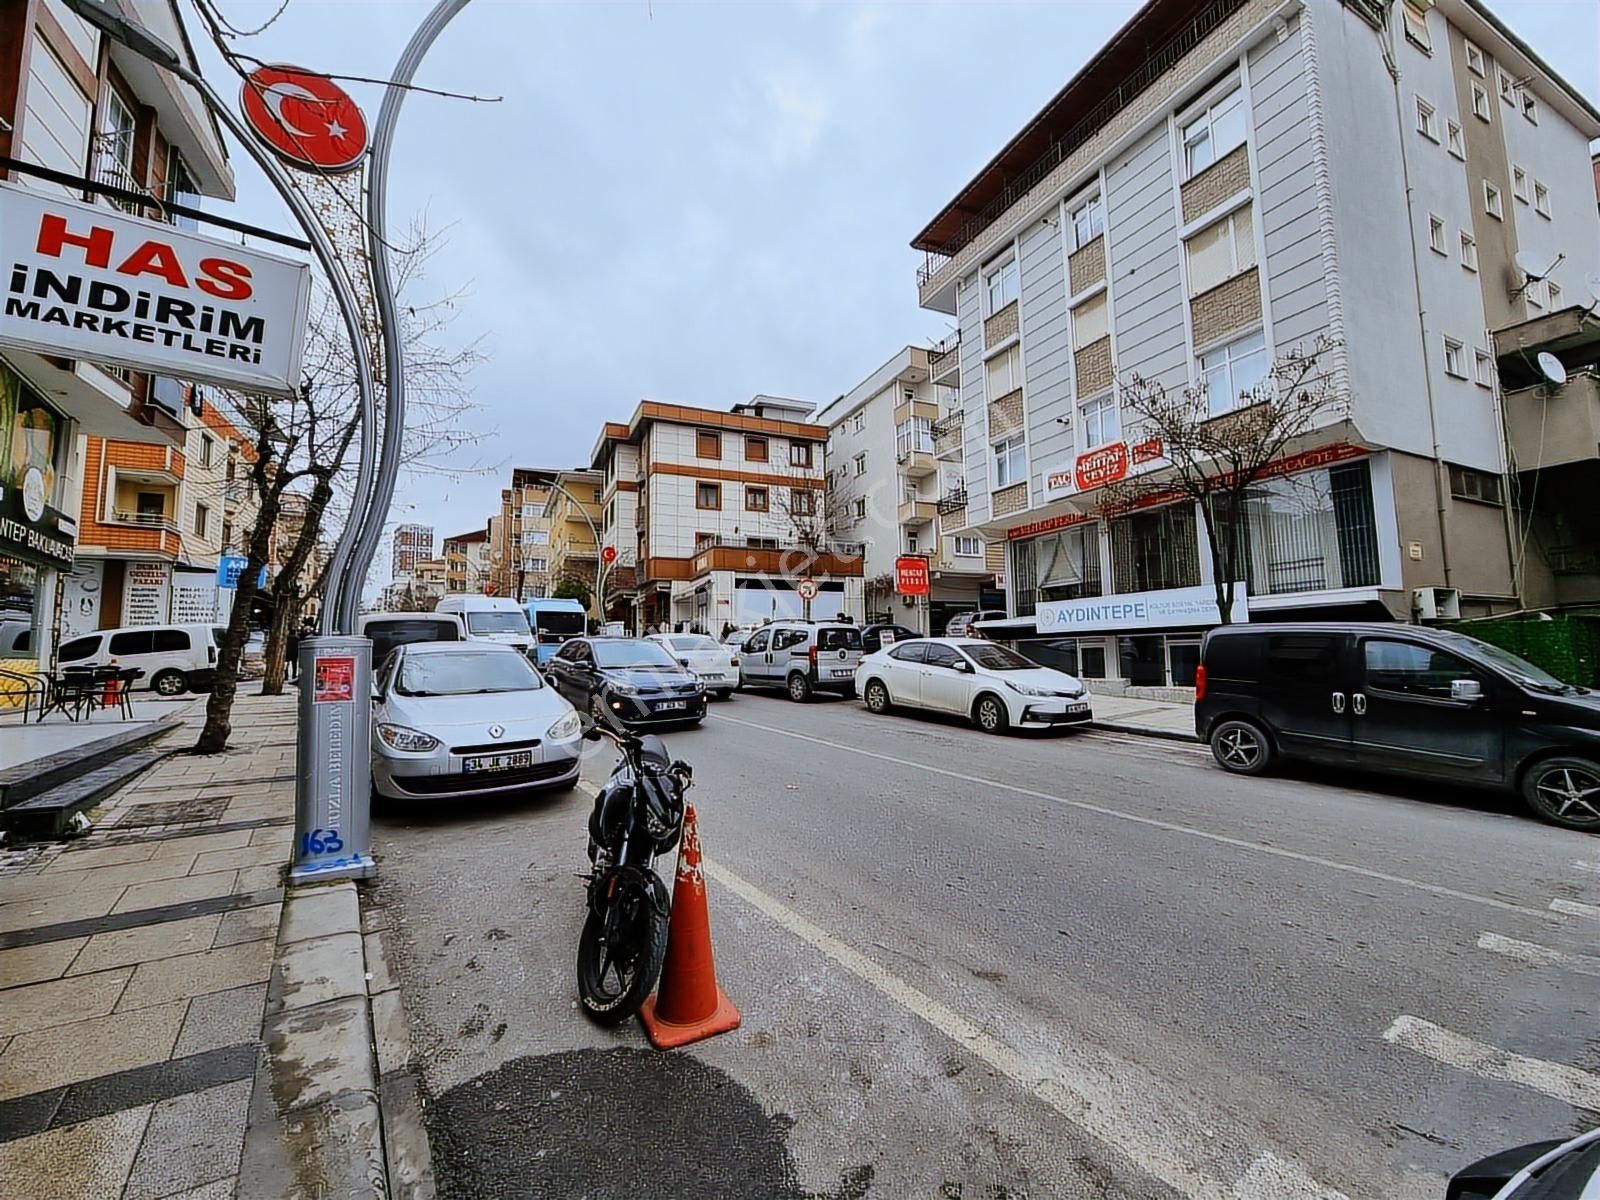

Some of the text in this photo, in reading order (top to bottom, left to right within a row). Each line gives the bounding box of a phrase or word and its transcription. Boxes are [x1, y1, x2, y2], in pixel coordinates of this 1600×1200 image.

[36, 212, 252, 301] HAS
[4, 297, 261, 364] MARKETLERİ
[1057, 602, 1145, 624] AYDINTEPE
[470, 758, 483, 769] 34
[328, 777, 343, 829] TUZLA
